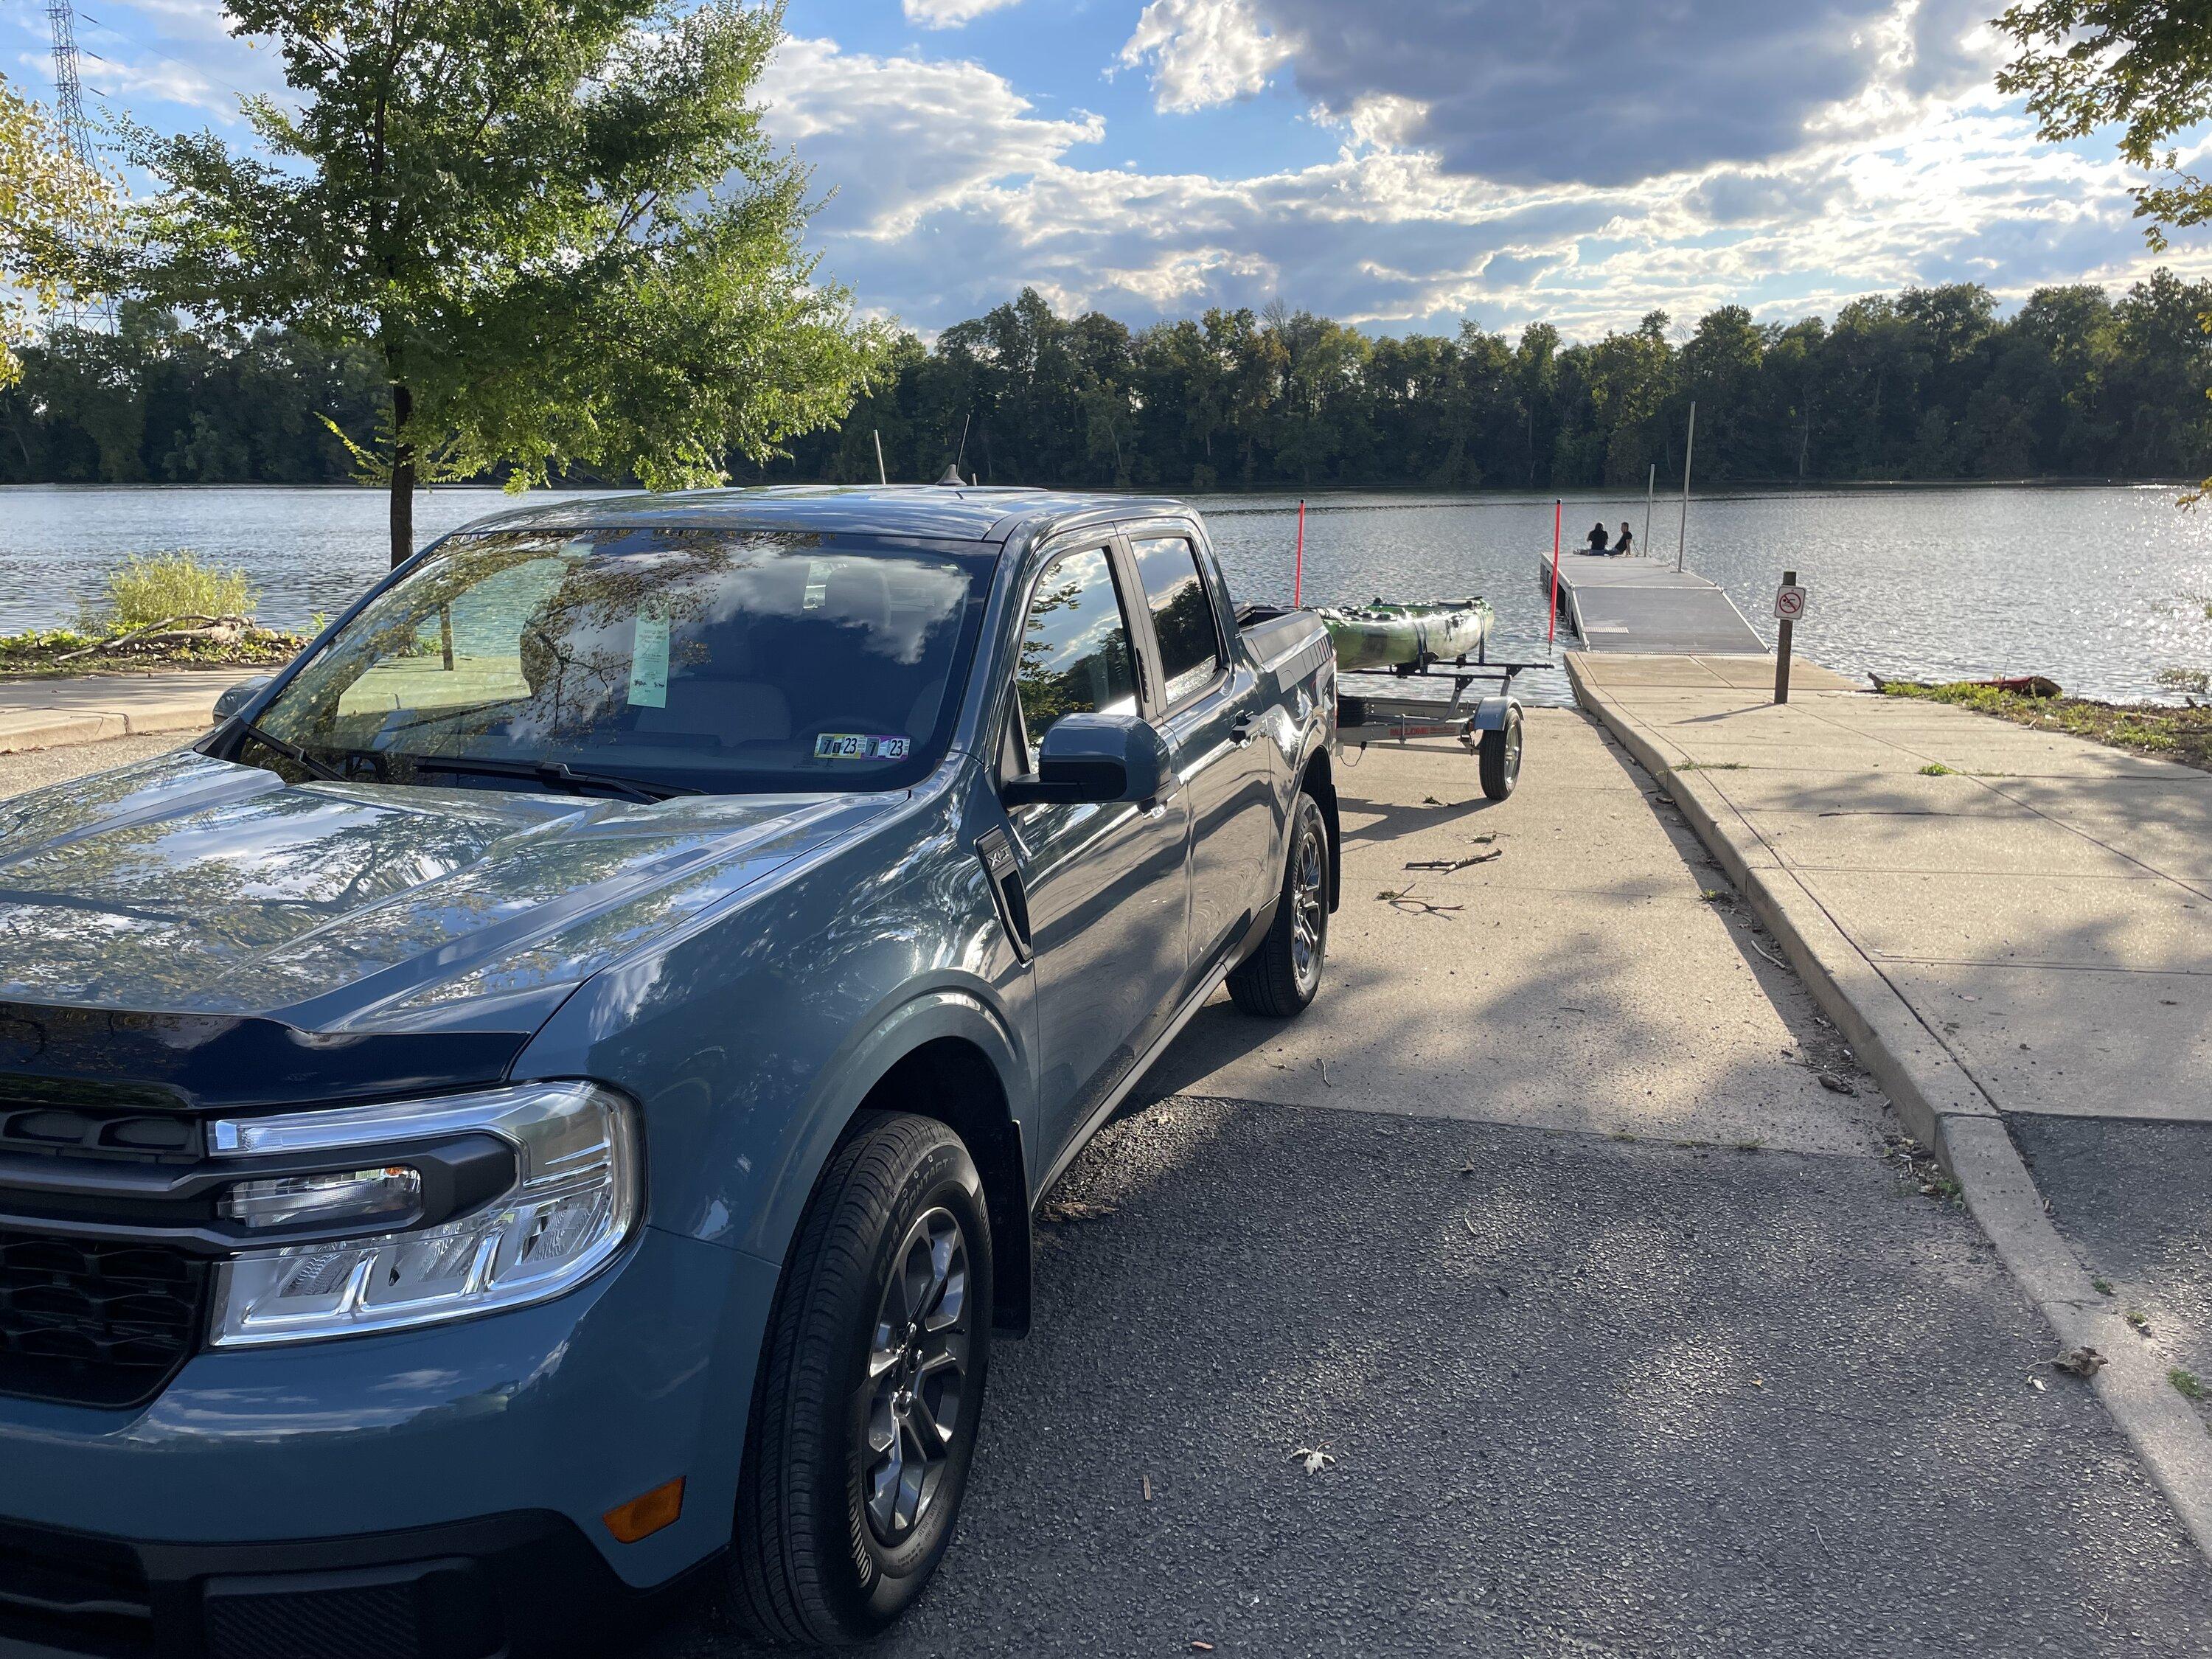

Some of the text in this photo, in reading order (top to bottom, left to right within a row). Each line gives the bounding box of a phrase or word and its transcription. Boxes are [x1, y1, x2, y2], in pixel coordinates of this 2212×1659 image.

[824, 737, 858, 754] 7 23
[869, 740, 903, 757] 7 23
[987, 845, 1010, 866] XLT
